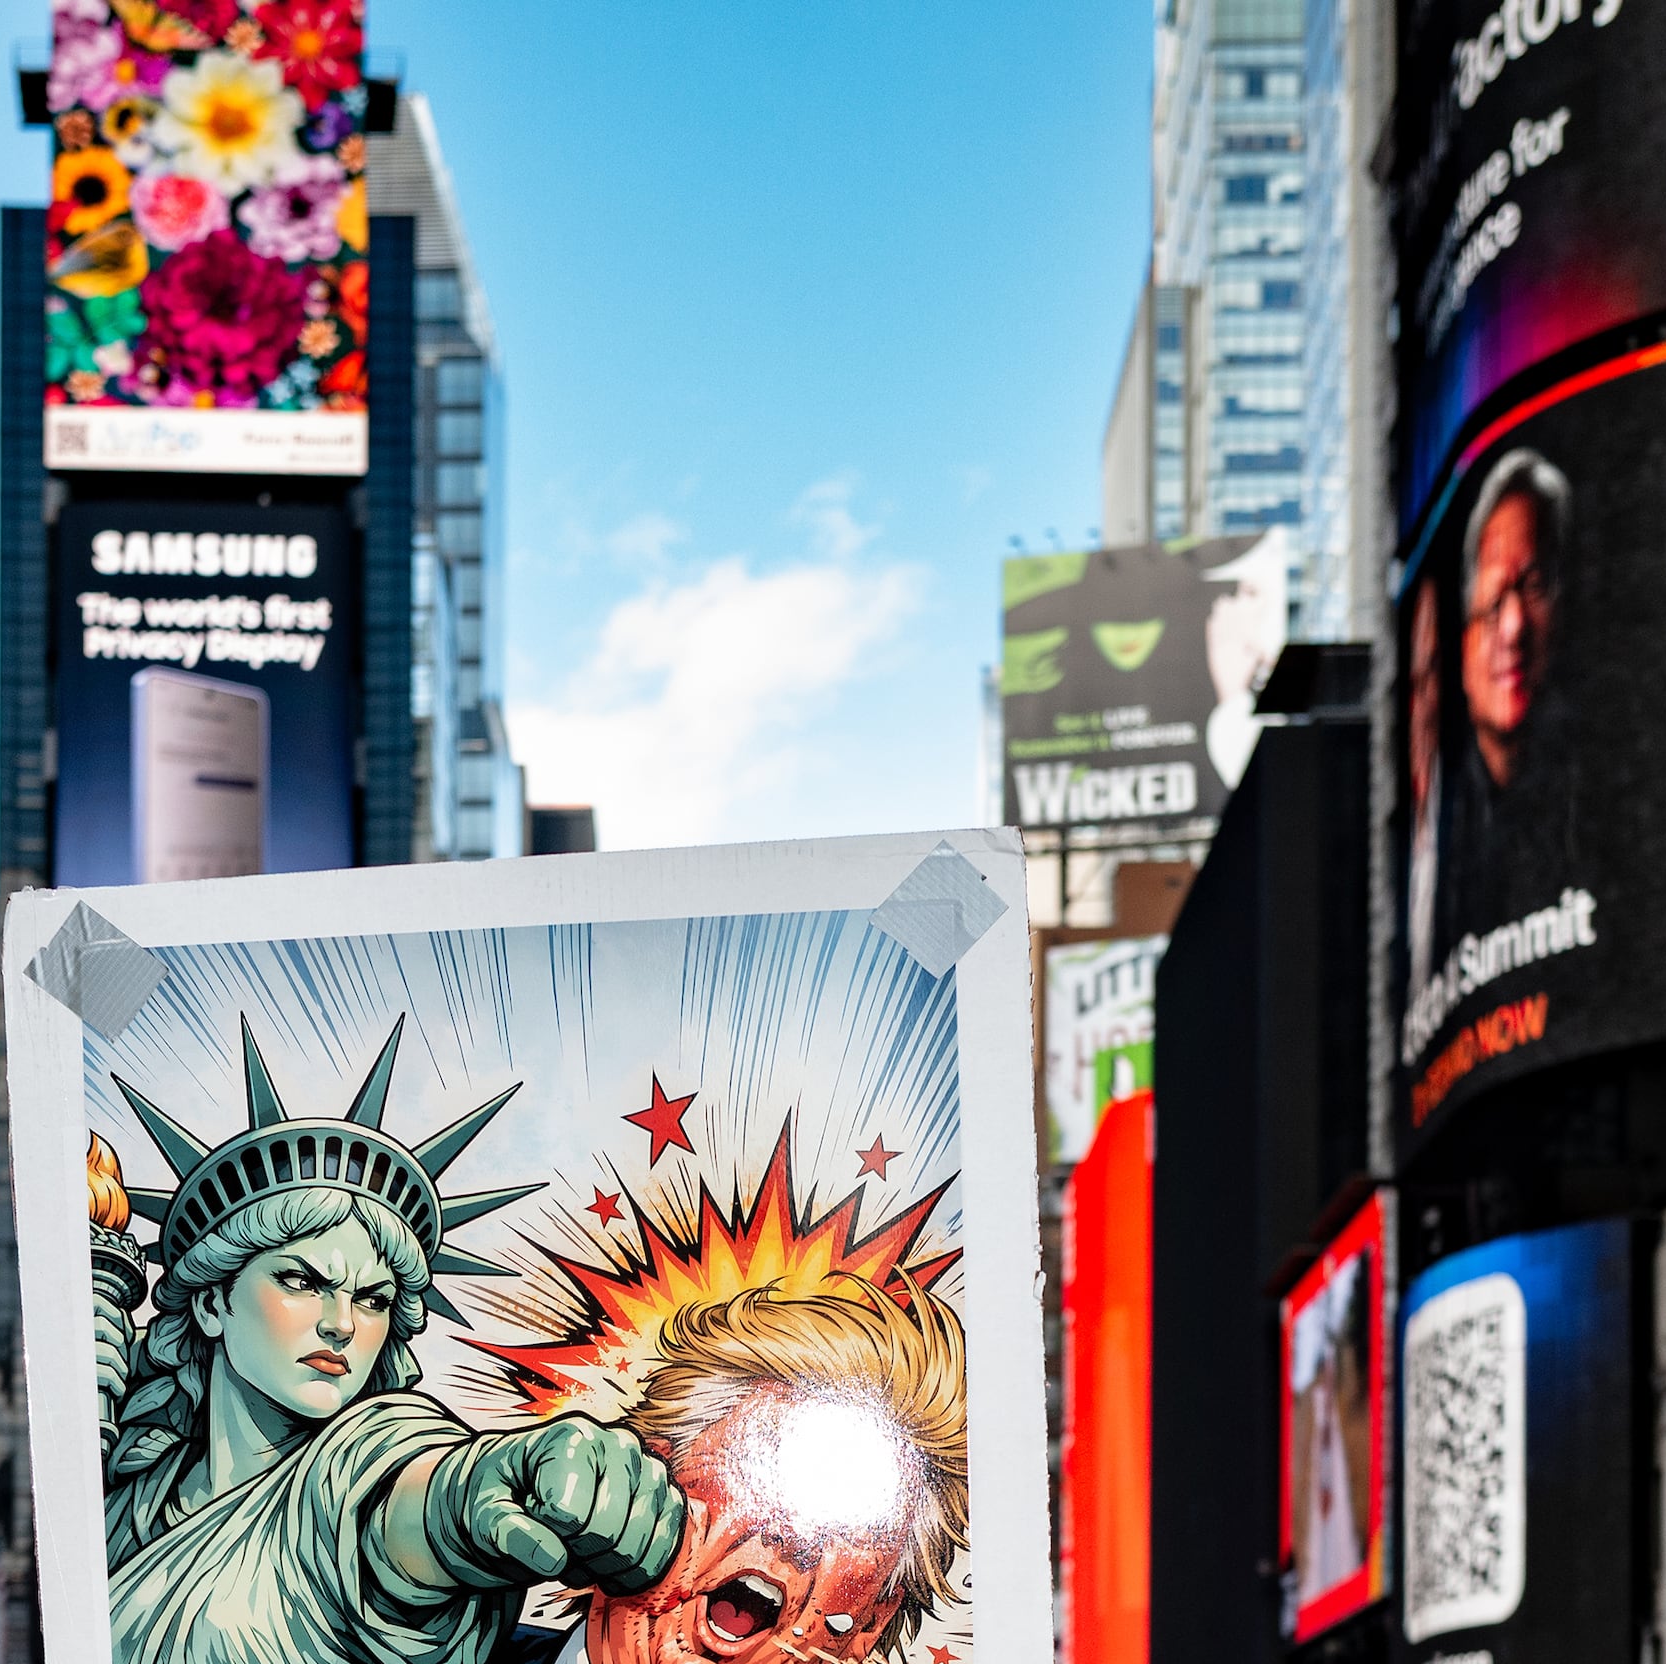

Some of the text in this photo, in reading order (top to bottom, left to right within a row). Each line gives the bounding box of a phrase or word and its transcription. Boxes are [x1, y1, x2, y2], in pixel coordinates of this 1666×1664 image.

[91, 529, 318, 578] SAMSUNG
[76, 591, 333, 632] The world's first
[82, 625, 326, 672] Privacy Display
[1457, 886, 1598, 995] Summit
